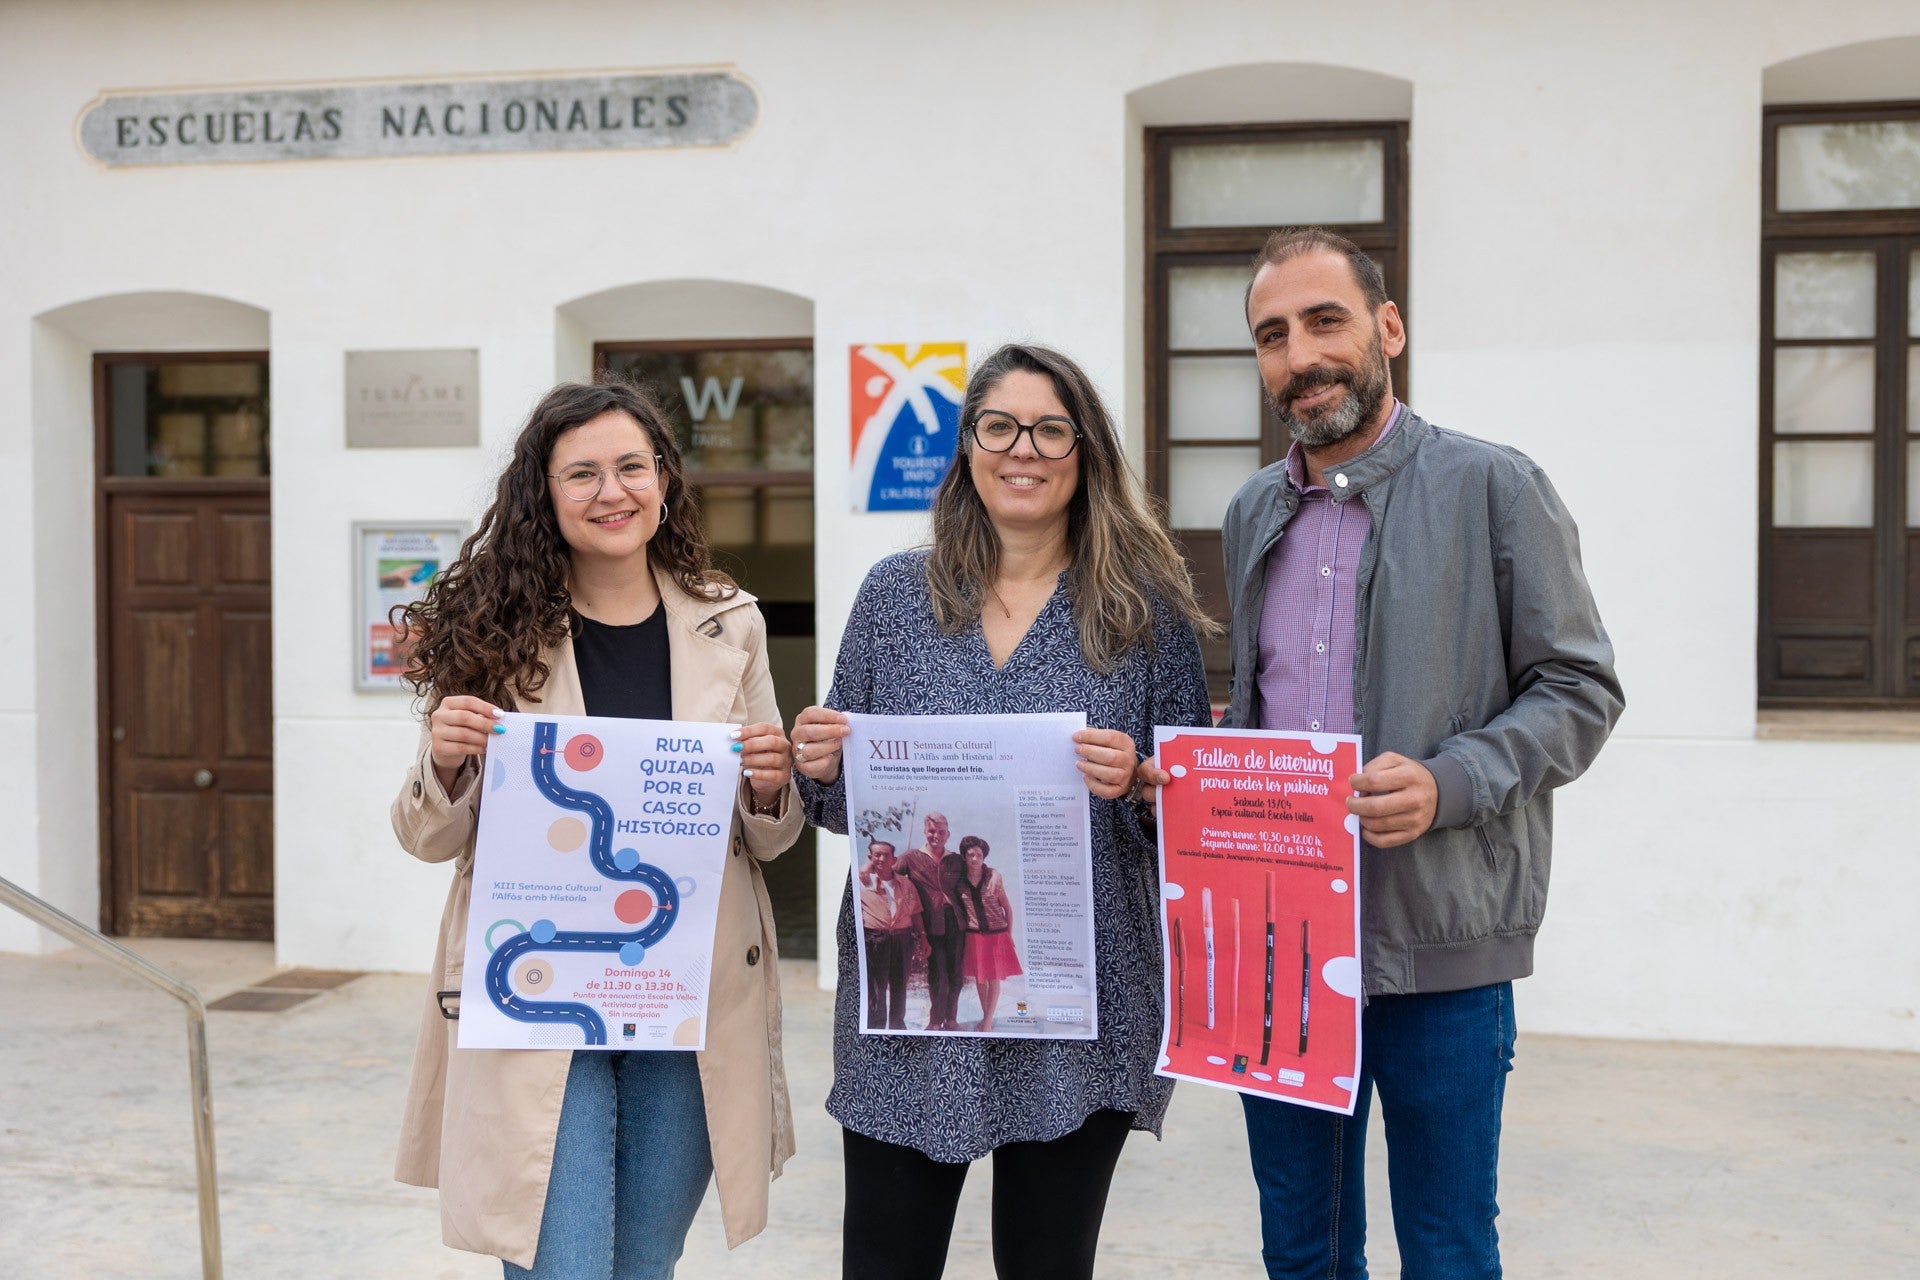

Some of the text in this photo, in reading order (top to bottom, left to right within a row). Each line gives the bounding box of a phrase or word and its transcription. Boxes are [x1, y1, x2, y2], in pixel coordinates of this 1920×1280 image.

[116, 95, 690, 148] ESCUELAS NACIONALES
[680, 376, 744, 421] W
[893, 456, 946, 470] TOURIST
[902, 470, 936, 482] INFO
[656, 738, 704, 754] RUTA
[868, 740, 992, 760] XIII Setmana Cultural
[942, 753, 959, 761] amb
[1192, 747, 1334, 780] Taller de lettering
[912, 766, 924, 774] que
[926, 765, 956, 774] llegaron
[644, 780, 706, 796] POR EL
[1200, 776, 1329, 797] para todos los públicos
[642, 800, 702, 816] CASCO
[1267, 798, 1292, 810] 13/04
[1211, 806, 1314, 822] Espai cultural Escoles Velles
[617, 820, 721, 836] HISTÓRICO
[1202, 826, 1323, 846] Primer turno: 10.30 a 12.00 h.
[1200, 837, 1325, 858] Segundo turno: 12.00 a 13.30 h.
[518, 882, 562, 891] Setmana
[566, 884, 602, 892] Cultural
[525, 893, 548, 901] amb
[605, 968, 671, 980] Domingo 14
[586, 980, 600, 990] de
[603, 981, 632, 990] 11.30
[645, 982, 674, 991] 13.30
[677, 982, 686, 992] h.
[638, 1002, 669, 1010] gratuita
